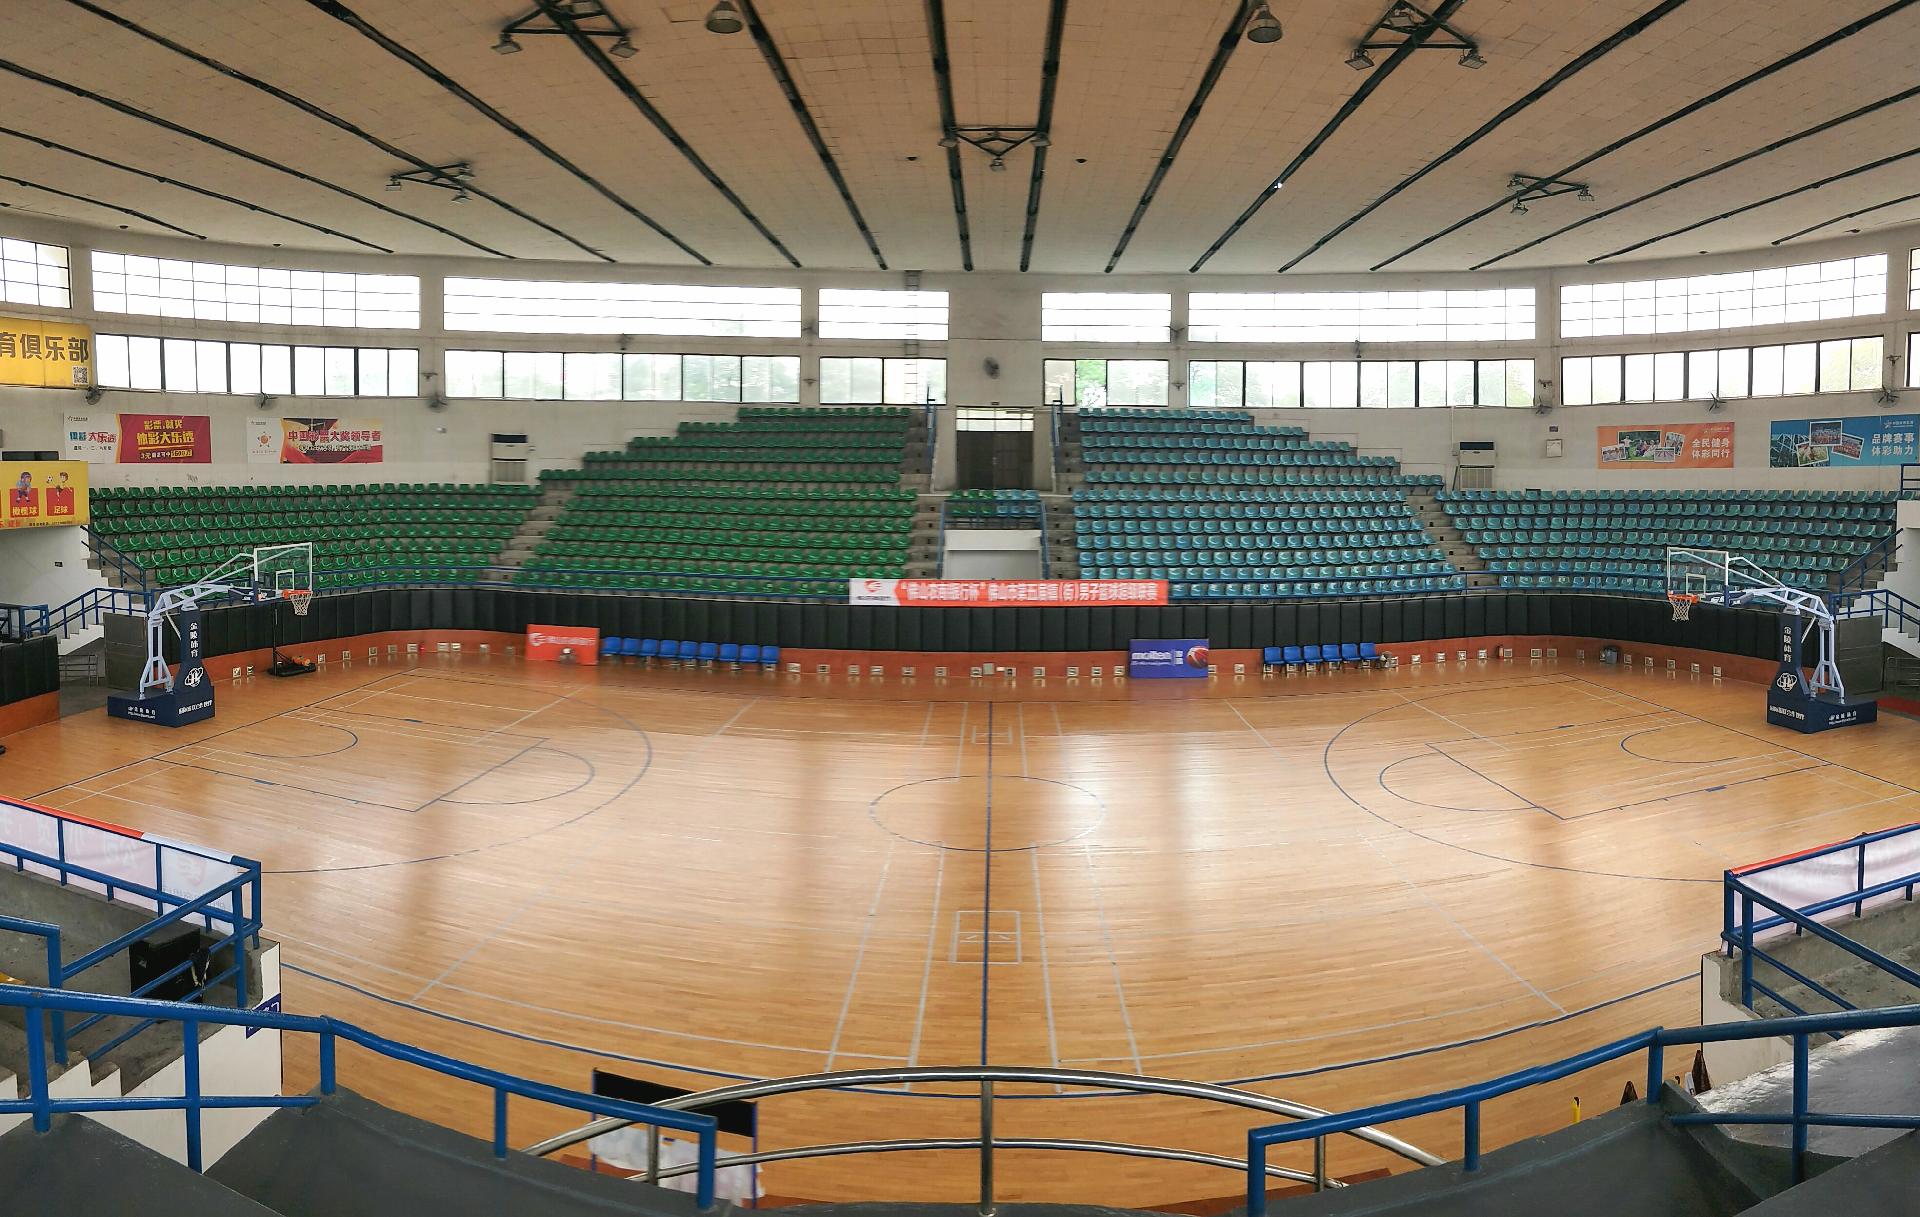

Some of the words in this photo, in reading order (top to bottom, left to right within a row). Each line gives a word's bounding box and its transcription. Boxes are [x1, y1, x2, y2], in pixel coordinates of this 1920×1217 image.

[0, 332, 89, 363] 育俱乐部
[137, 431, 195, 445] 体彩大乐透
[1692, 438, 1730, 448] 全民健身
[1871, 433, 1915, 445] 品牌赛事
[1692, 450, 1730, 459] 体彩同行
[1872, 445, 1914, 456] 体彩助力
